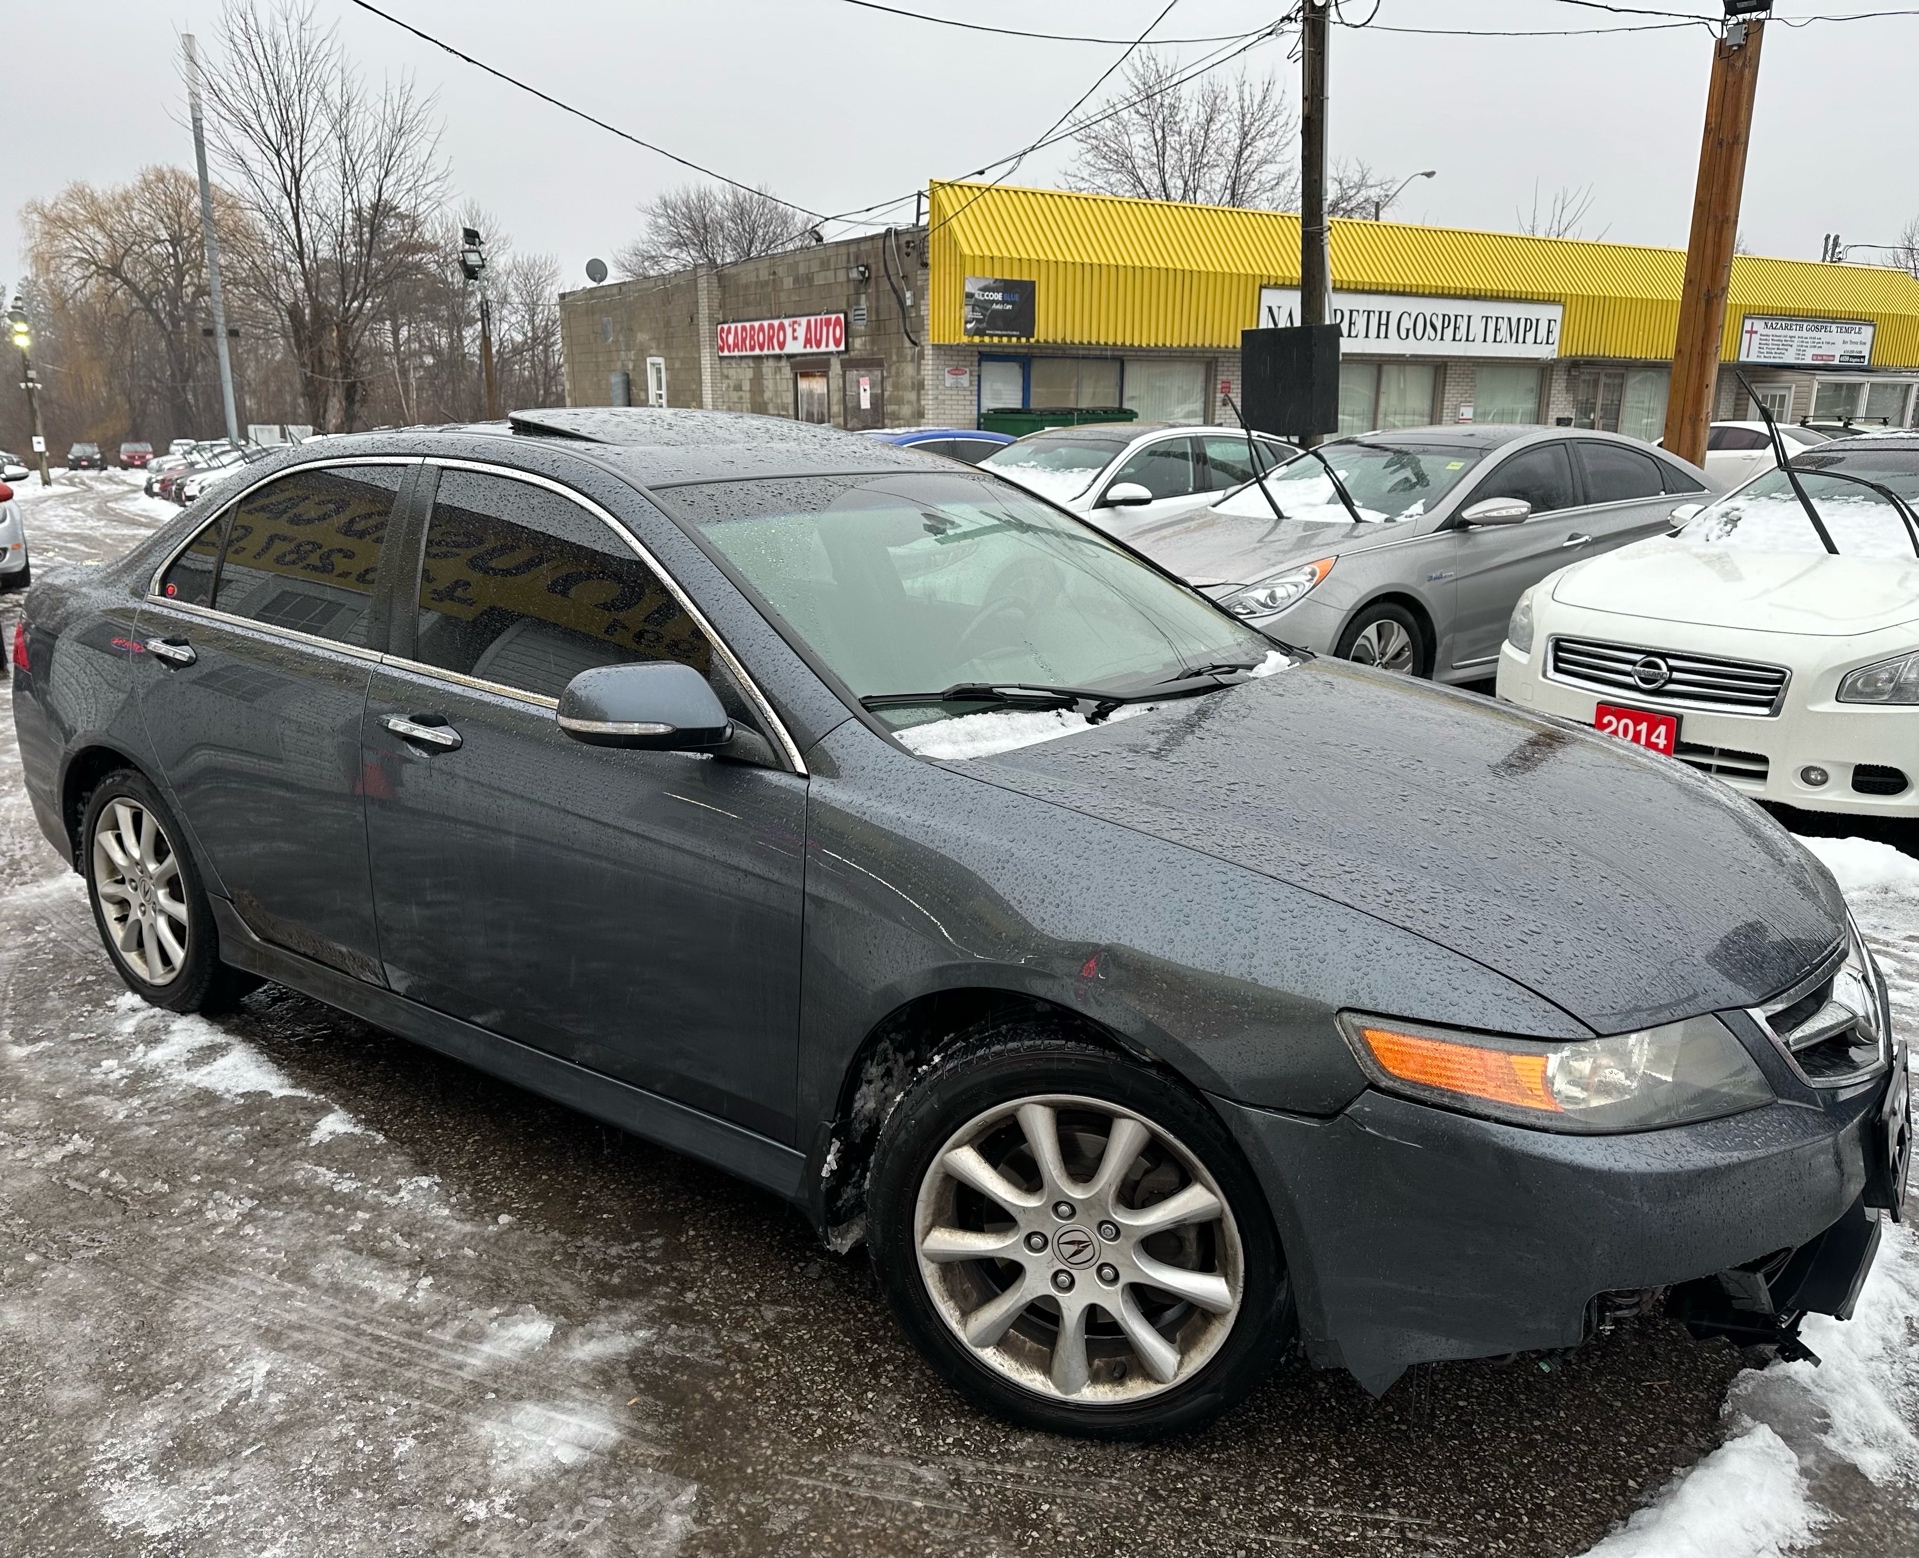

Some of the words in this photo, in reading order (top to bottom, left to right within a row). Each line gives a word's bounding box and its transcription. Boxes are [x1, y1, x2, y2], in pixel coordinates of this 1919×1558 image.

[1004, 292, 1020, 302] BLUE
[718, 321, 787, 354] SCARBORO
[803, 315, 844, 349] AUTO
[1266, 305, 1391, 339] NARETH
[1396, 310, 1477, 343] GOSPEL
[1481, 315, 1558, 346] TEMPLE
[1763, 321, 1804, 332] NAZARETH
[1805, 324, 1834, 334] GOSPEL
[1835, 326, 1863, 335] TEMPLE
[1632, 667, 1668, 681] NISSAN
[1602, 714, 1668, 750] 2014
